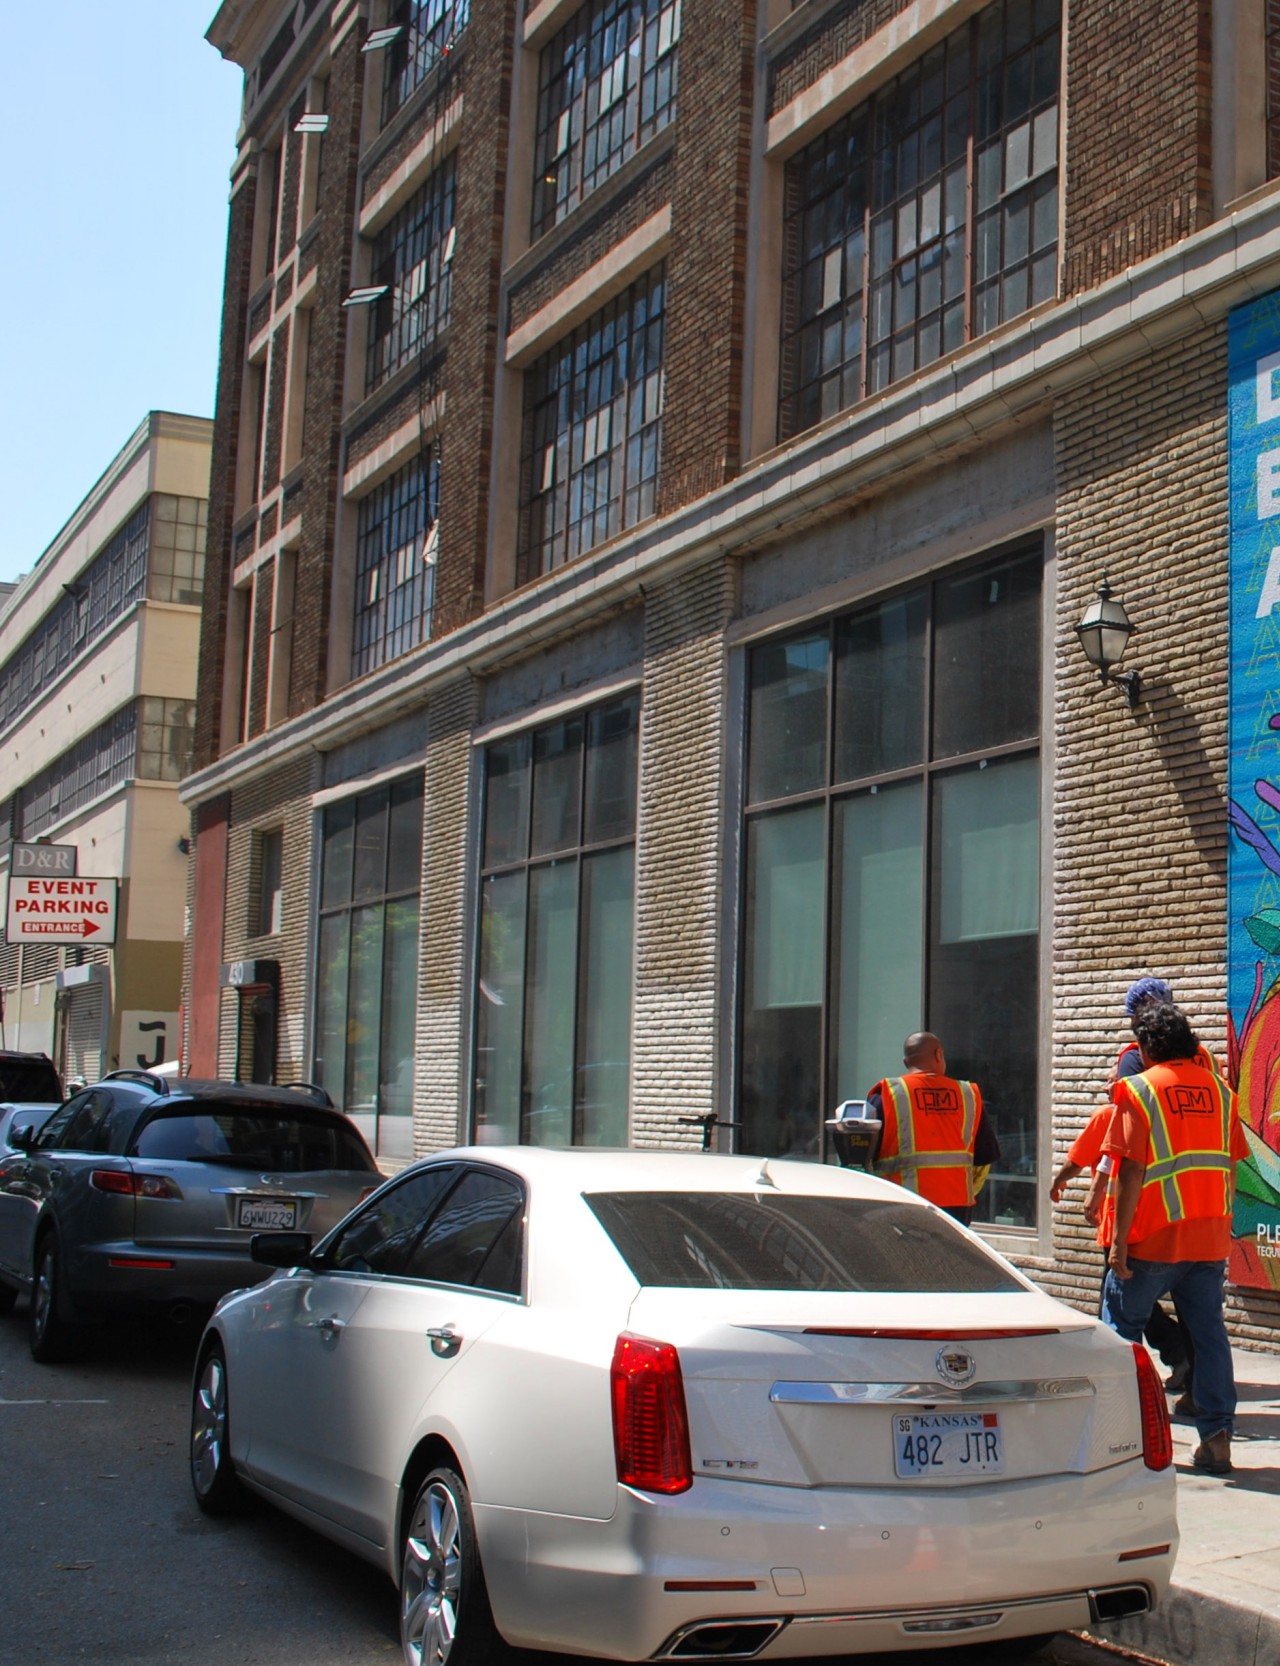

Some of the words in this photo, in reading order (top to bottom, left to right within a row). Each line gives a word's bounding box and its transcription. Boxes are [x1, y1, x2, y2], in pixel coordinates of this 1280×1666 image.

[18, 848, 70, 870] D&R
[27, 880, 98, 895] EVENT
[15, 899, 109, 914] PARKING
[24, 922, 85, 932] ENTRANCE
[899, 1419, 910, 1432] SG
[920, 1415, 978, 1428] KANSAS
[902, 1435, 943, 1466] 482
[960, 1432, 999, 1463] JTR
